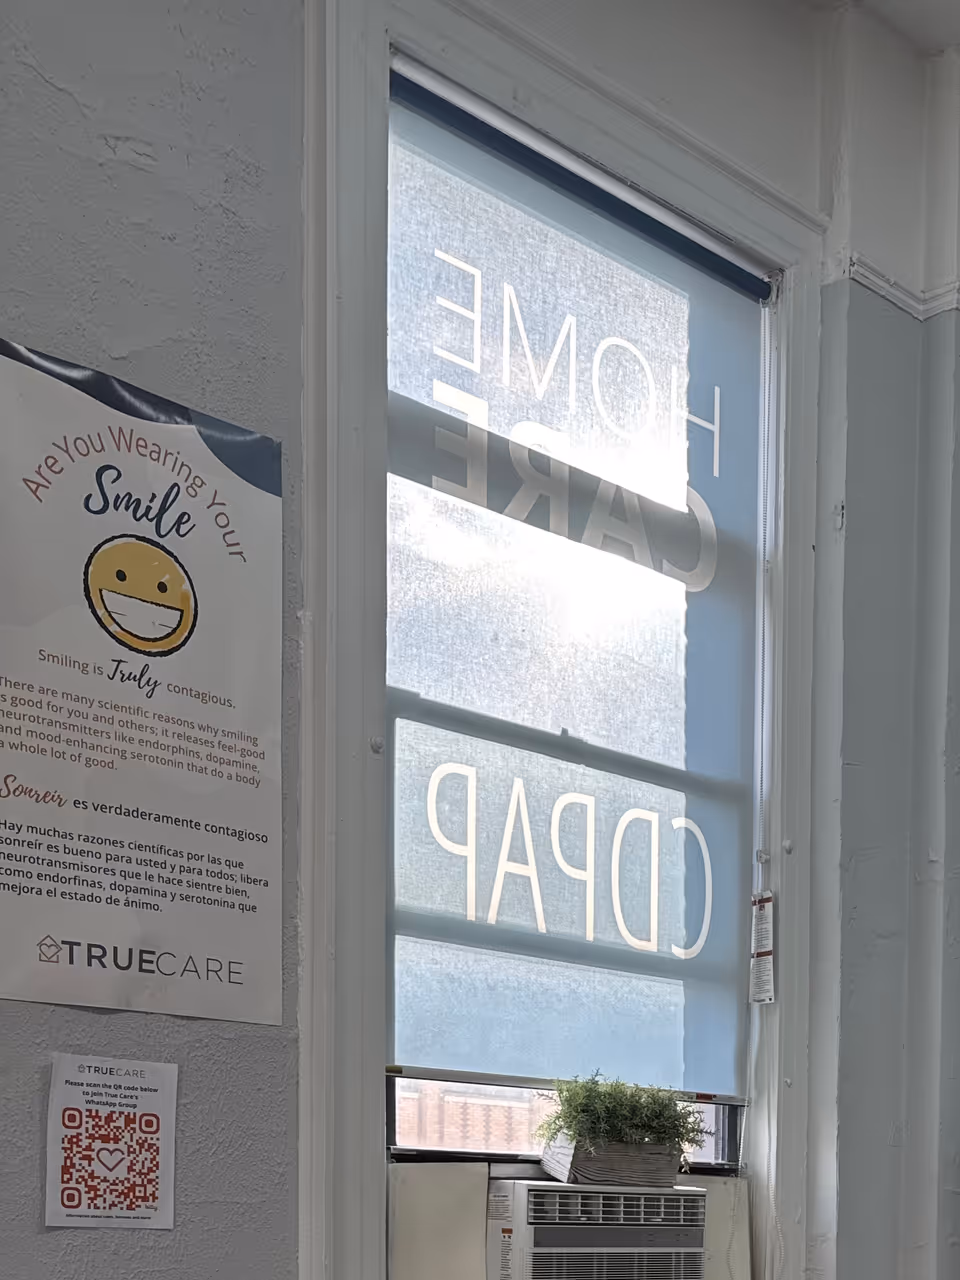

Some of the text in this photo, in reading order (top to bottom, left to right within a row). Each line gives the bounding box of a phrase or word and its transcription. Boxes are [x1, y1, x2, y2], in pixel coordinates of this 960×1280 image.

[22, 425, 247, 563] Are You Wearing Your
[84, 464, 196, 538] Smile
[38, 649, 89, 675] Smiling
[93, 662, 104, 676] is
[107, 658, 161, 699] Truly
[0, 676, 259, 747] There are many scientific reasons why smiling
[10, 695, 43, 709] good
[47, 701, 64, 714] for
[66, 708, 89, 720] you
[92, 713, 115, 726] and
[118, 719, 158, 736] others;
[161, 726, 169, 738] it
[172, 731, 215, 749] releases
[217, 740, 265, 760] feel-good
[0, 709, 260, 775] neurotransmitters like endorphins, dopamine,
[0, 724, 261, 789] and mood-enhancing serotonin that do a body
[8, 740, 48, 756] whole
[51, 747, 67, 760] lot
[70, 752, 82, 764] of
[84, 757, 118, 771] good.
[0, 819, 245, 870] Hay muchas razones científicas por las que
[73, 799, 88, 810] es
[92, 802, 201, 831] verdaderamente
[204, 823, 268, 843] contagioso
[0, 836, 269, 888] sonreír es bueno para usted y para todos; libera
[0, 851, 250, 900] neurotransmisores que le hace sientre bien,
[0, 866, 257, 913] como endorfinas, dopamina y serotonina que
[0, 882, 163, 912] mejora el estado de ánimo.
[61, 939, 244, 985] TRUECARE
[64, 1080, 84, 1088] Please
[102, 1082, 112, 1090] the
[123, 1084, 139, 1092] code
[86, 1065, 146, 1079] TRUECARE
[118, 1101, 138, 1109] Group
